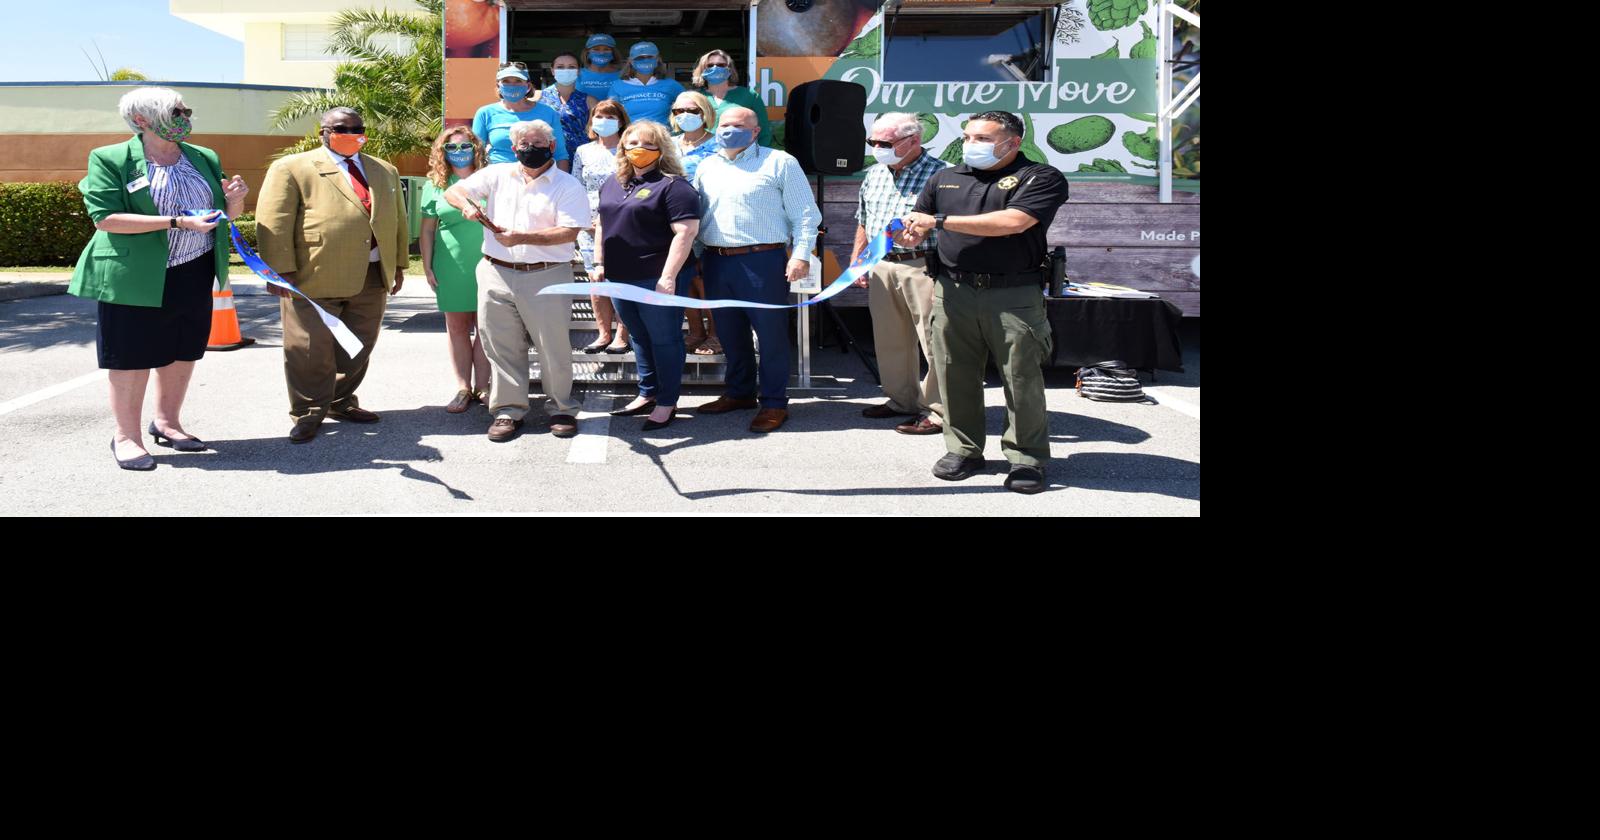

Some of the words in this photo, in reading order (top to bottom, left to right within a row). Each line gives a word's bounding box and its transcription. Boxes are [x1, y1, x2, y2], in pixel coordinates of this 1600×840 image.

[1017, 66, 1137, 109] Move
[1140, 230, 1186, 241] Made
[1190, 231, 1200, 241] P
